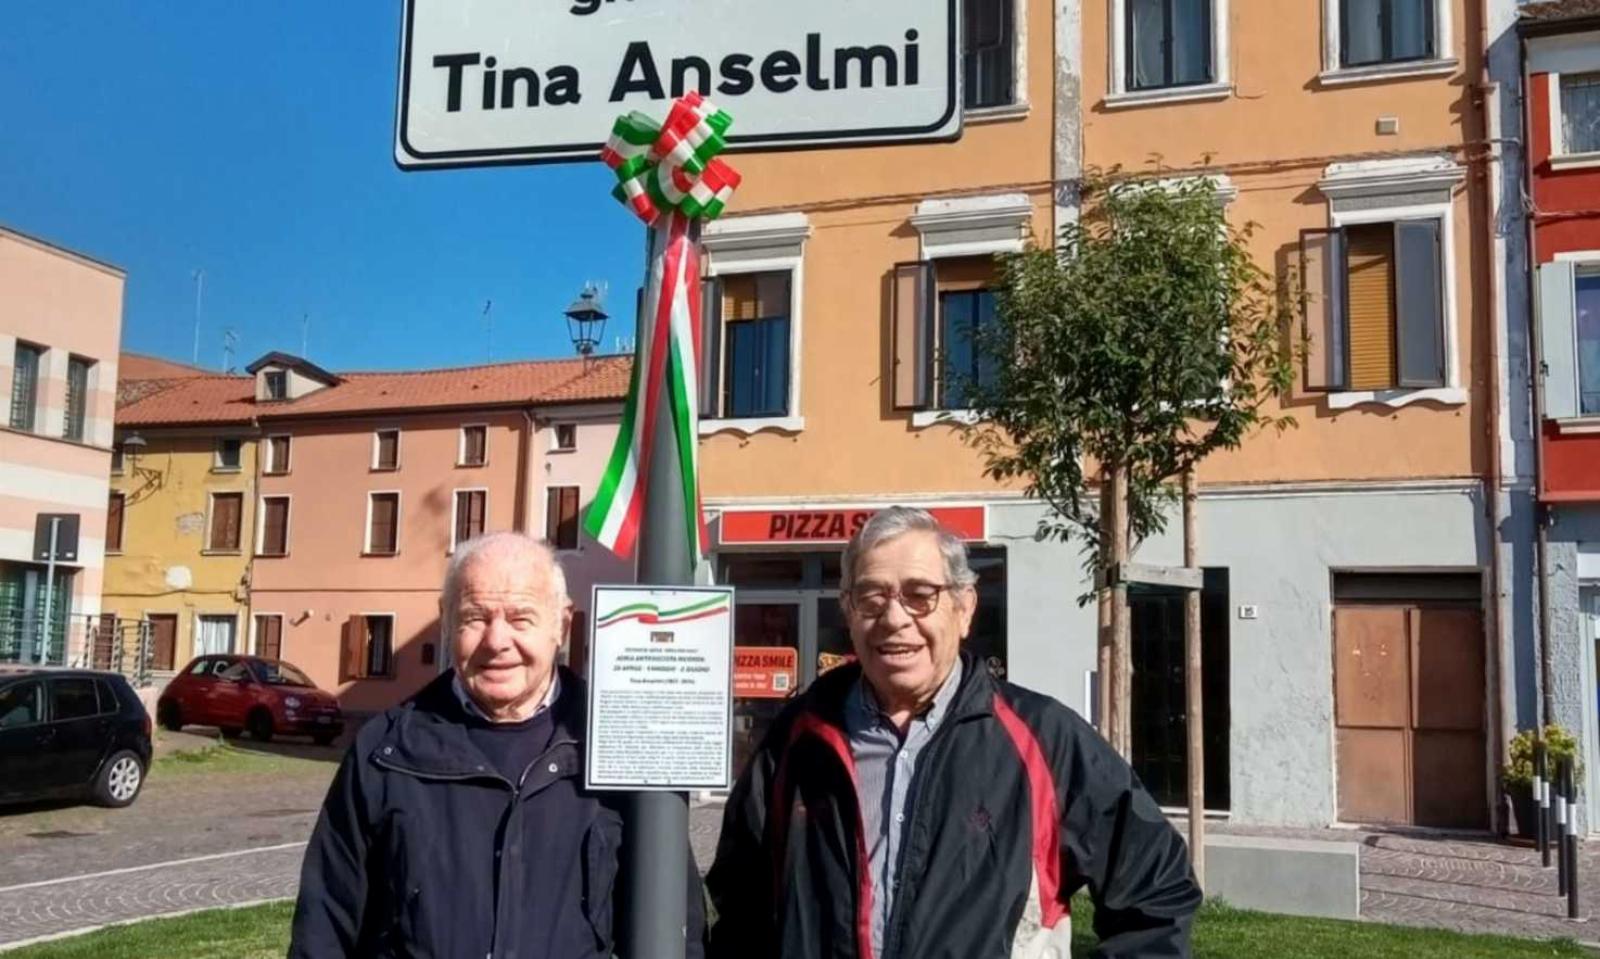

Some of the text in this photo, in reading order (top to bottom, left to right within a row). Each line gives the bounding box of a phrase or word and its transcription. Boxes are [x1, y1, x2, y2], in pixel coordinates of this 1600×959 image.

[433, 28, 921, 112] Tina Anselmi
[769, 513, 846, 540] PIZZA
[762, 655, 794, 667] SMILE
